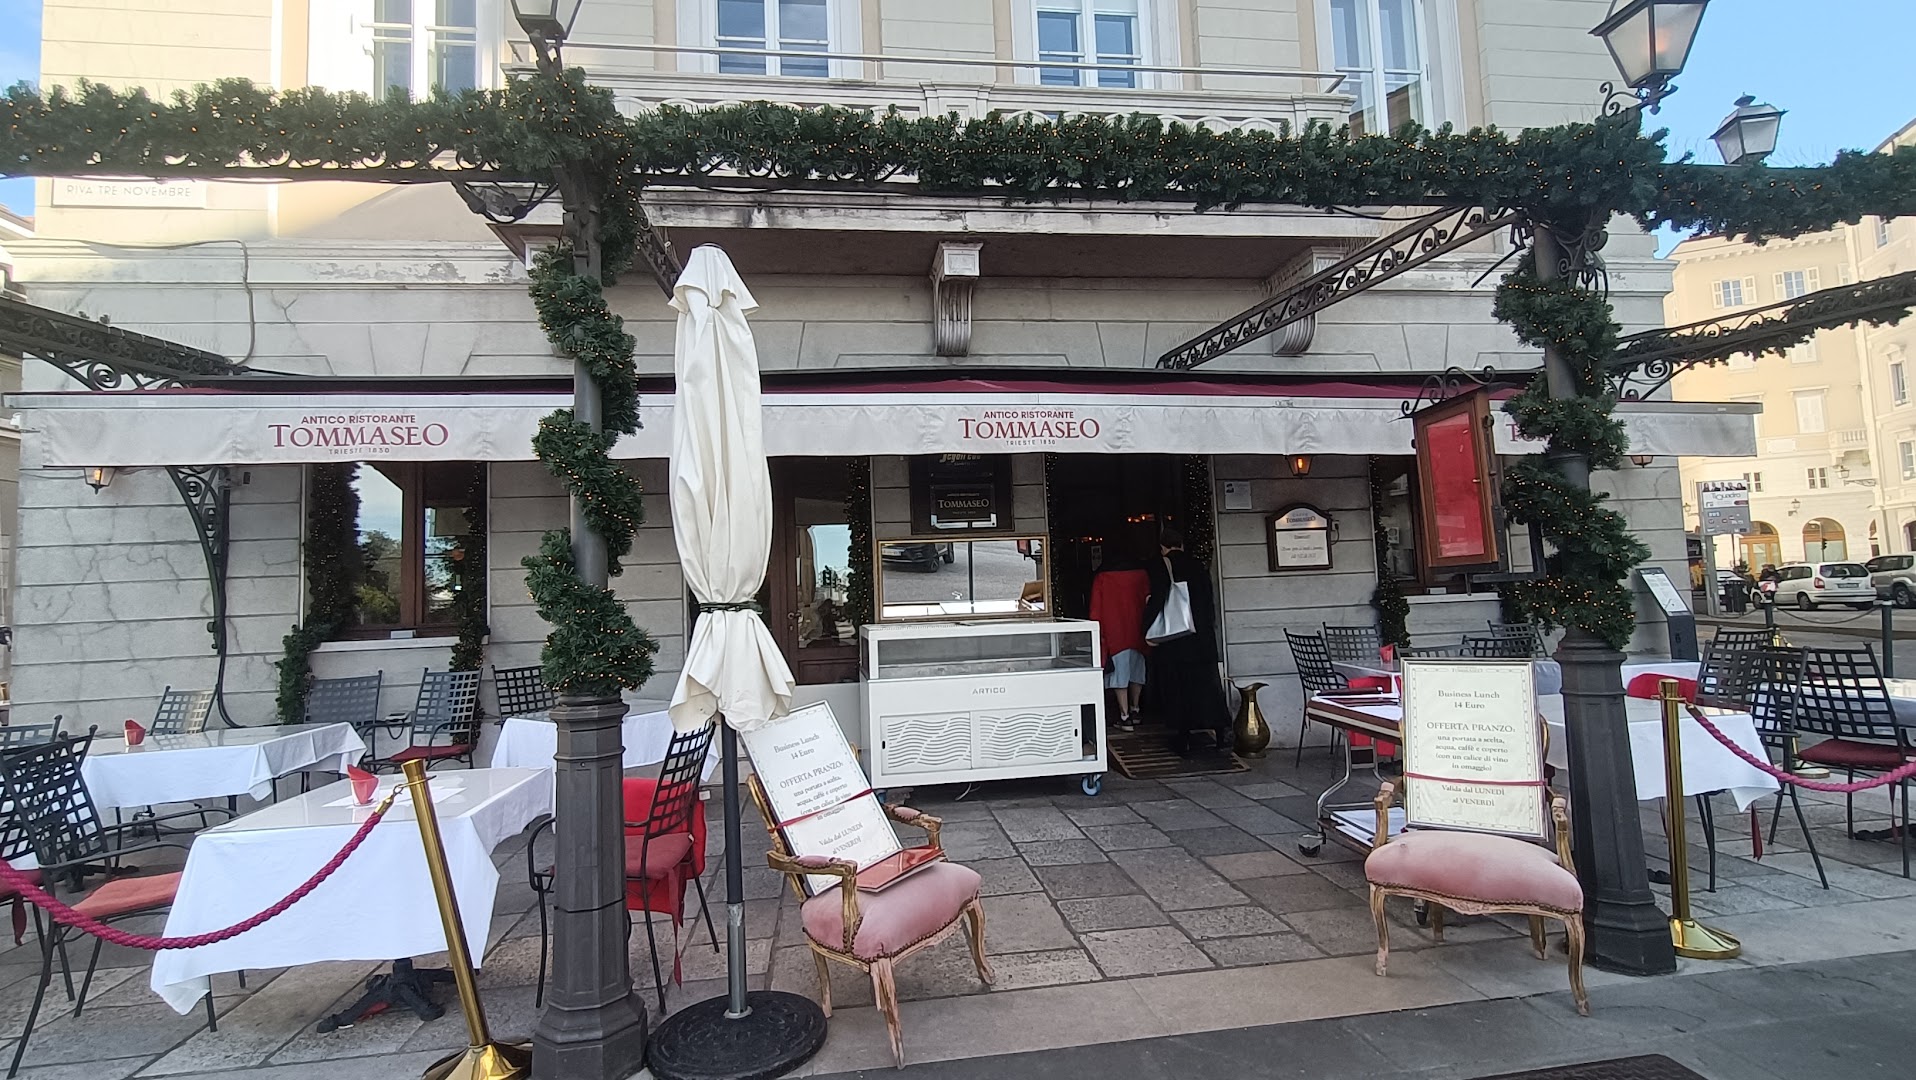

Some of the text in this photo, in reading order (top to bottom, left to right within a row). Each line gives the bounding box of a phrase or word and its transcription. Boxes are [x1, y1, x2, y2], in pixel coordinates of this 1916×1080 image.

[66, 184, 192, 197] RIVA TRE NOVEMBRE
[301, 414, 416, 424] ANTICO RISTORANTE
[983, 410, 1074, 419] ANTICO RISTORANTE
[957, 418, 1100, 439] TOMMASEO
[267, 423, 449, 447] TOMMASEO
[328, 447, 363, 455] TRIESTE
[938, 499, 990, 509] TOMMASEO
[972, 687, 1006, 695] ARTICO
[1438, 690, 1500, 699] Business Lunch
[1426, 722, 1516, 733] OFFERTA PRANZO:
[774, 733, 820, 754] Business Lunch
[791, 748, 815, 760] 14 Euro
[780, 771, 814, 788] OFFERTA
[793, 789, 804, 797] una
[804, 783, 823, 794] portata
[829, 783, 848, 793] coperto
[1441, 784, 1461, 792] Valida
[1474, 787, 1505, 795] LUNEDÌ
[821, 800, 834, 808] calice
[1460, 797, 1495, 806] VENERDÌ
[818, 838, 834, 846] Valida
